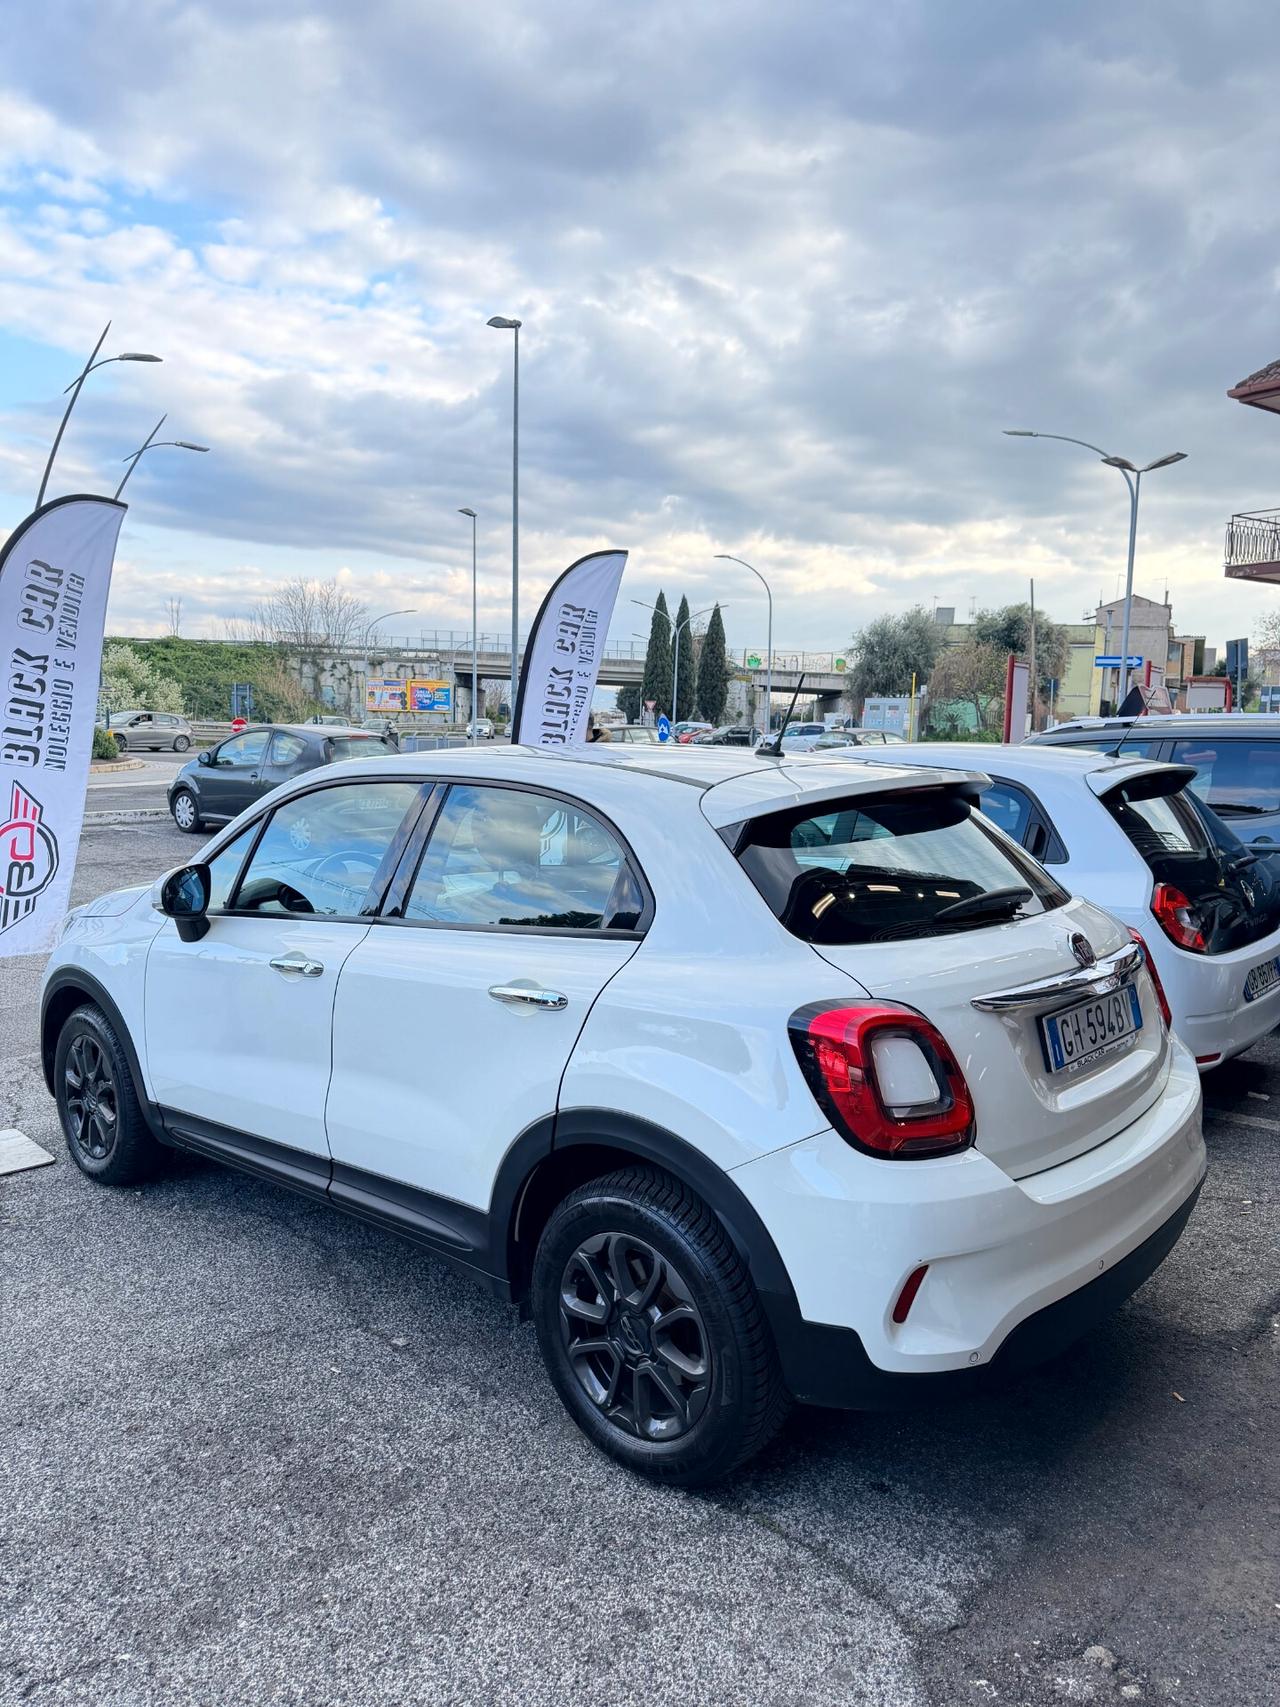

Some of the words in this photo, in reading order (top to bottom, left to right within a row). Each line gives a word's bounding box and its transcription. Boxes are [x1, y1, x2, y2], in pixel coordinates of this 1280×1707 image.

[17, 559, 63, 636] CAR
[54, 572, 85, 651] VENDITA
[553, 603, 586, 656] CAR
[52, 658, 76, 672] E
[578, 609, 598, 665] VENDITA
[0, 647, 49, 768] BLACK
[43, 678, 74, 772] NOLEGGIO
[540, 666, 574, 743] BLACK
